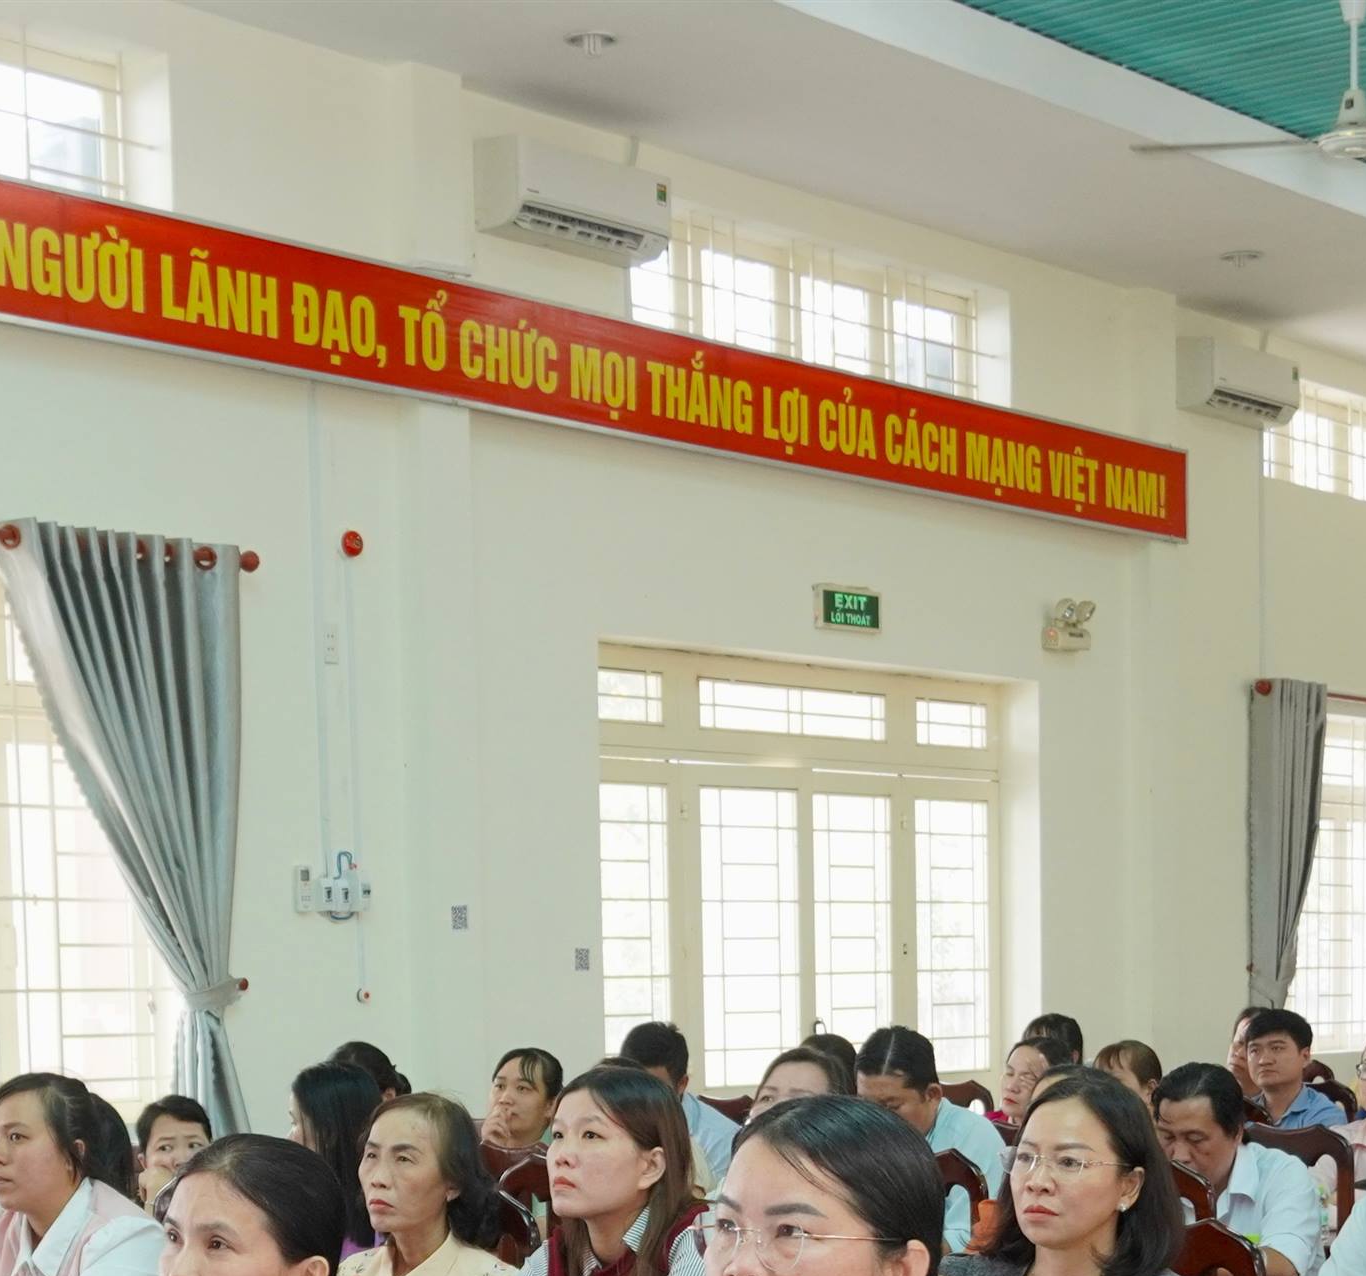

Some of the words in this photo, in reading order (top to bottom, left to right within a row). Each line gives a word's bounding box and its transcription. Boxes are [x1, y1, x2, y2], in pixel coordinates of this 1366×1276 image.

[160, 248, 278, 338] LÃNH
[292, 282, 386, 368] ĐẠO,
[399, 290, 447, 372] TỔ
[460, 317, 558, 394] CHỨC
[570, 343, 636, 420] MỌI
[647, 351, 753, 434] THẮNG
[763, 384, 809, 454] LỢI
[819, 387, 876, 460] CỦA
[885, 408, 957, 476] CÁCH
[966, 431, 1041, 496] MẠNG
[1049, 446, 1098, 512] VIỆT
[1105, 463, 1166, 519] NAM!
[834, 593, 867, 611] EXIT
[830, 607, 845, 623] LỐI
[846, 612, 871, 626] THOÁT
